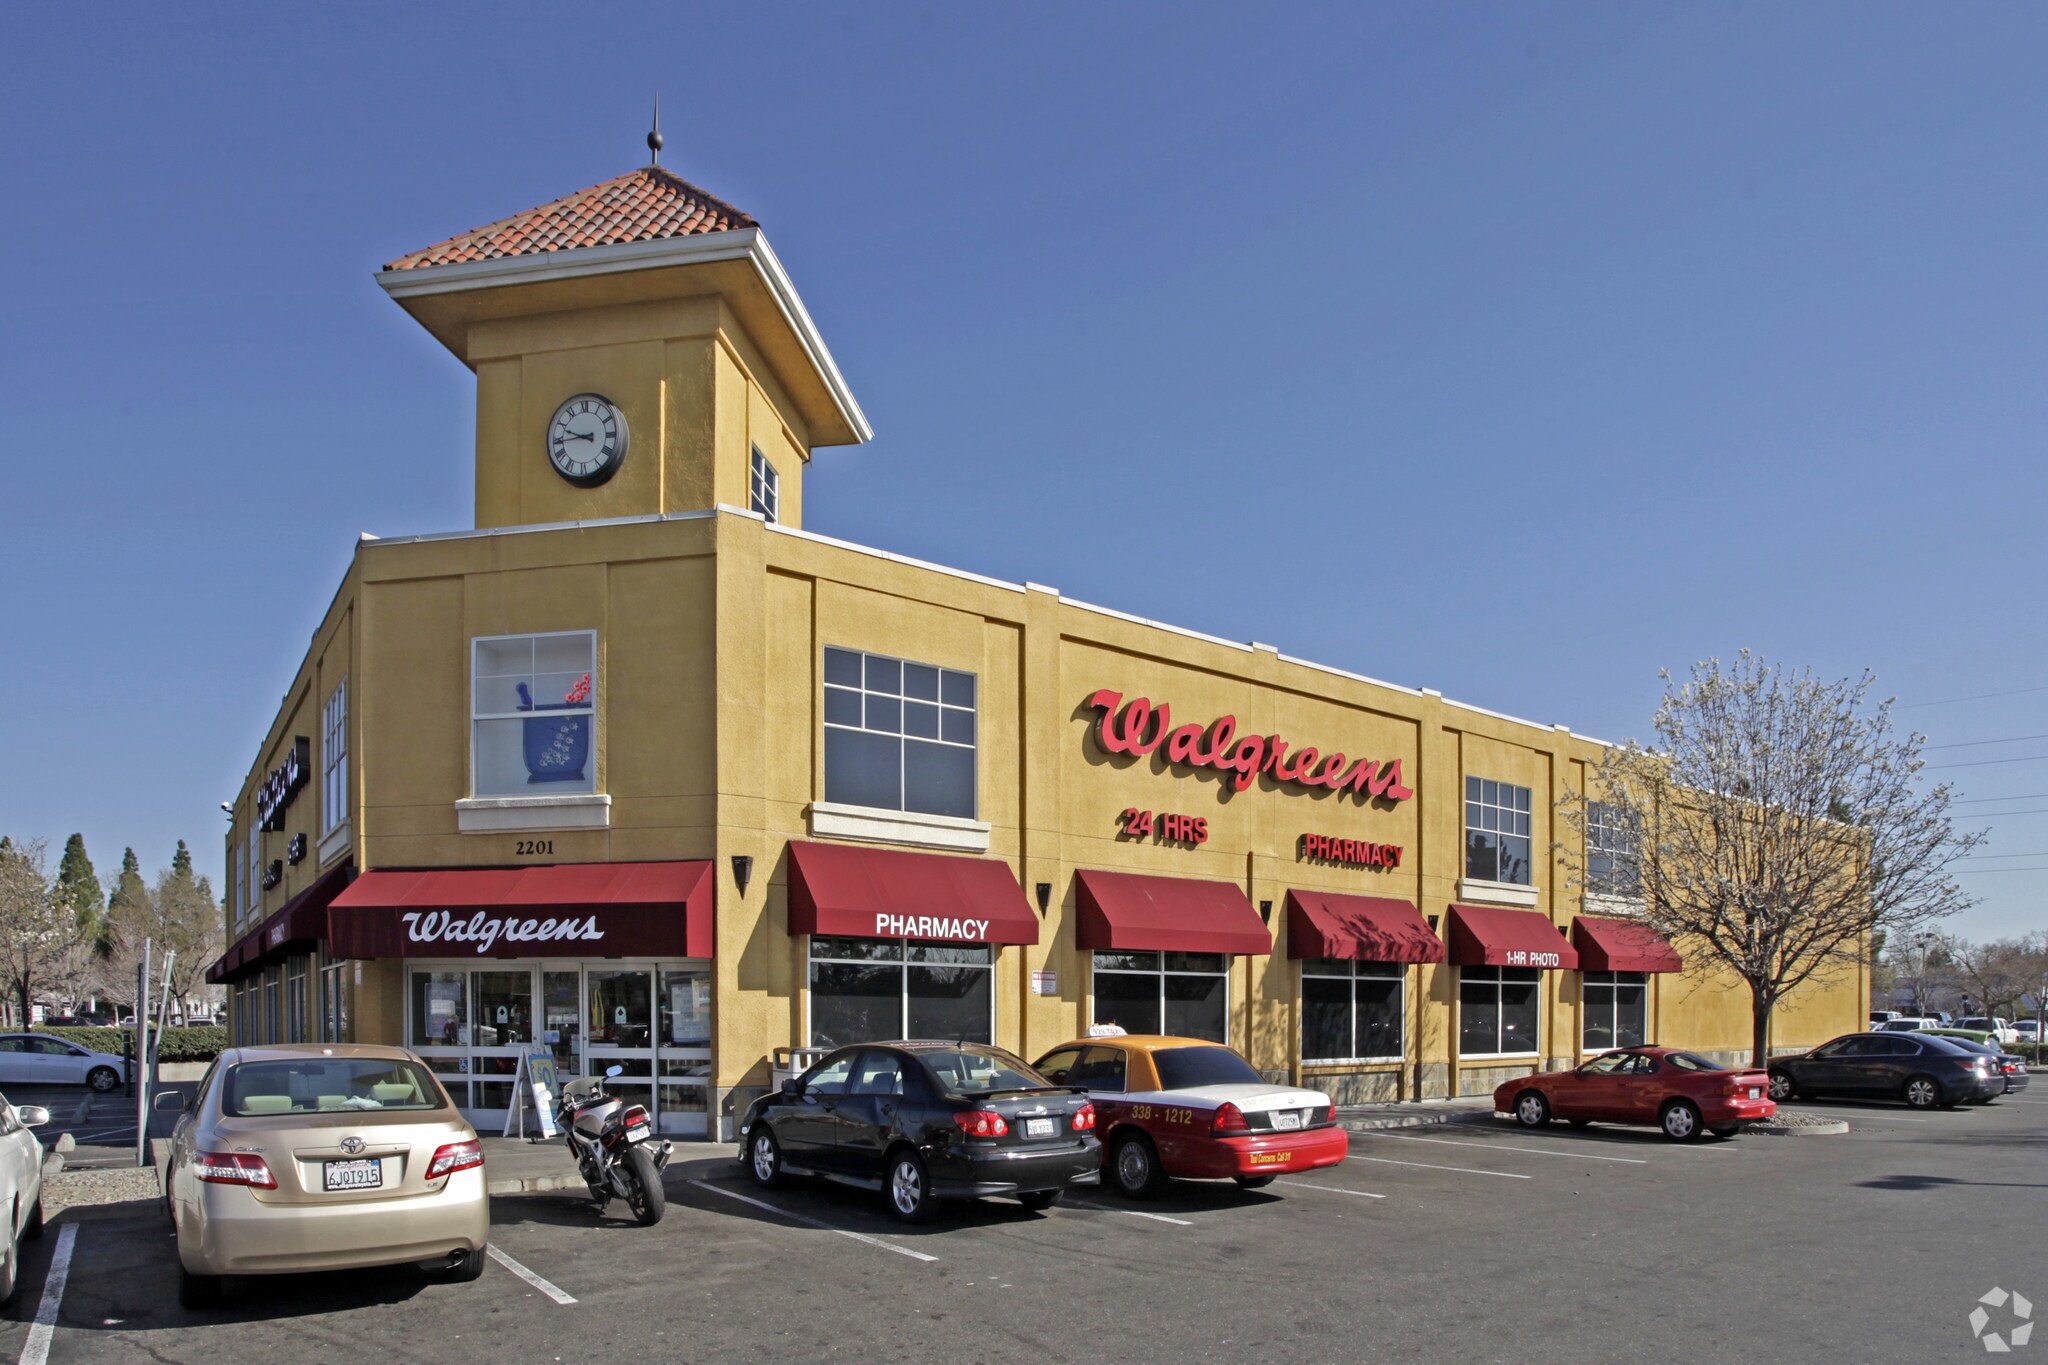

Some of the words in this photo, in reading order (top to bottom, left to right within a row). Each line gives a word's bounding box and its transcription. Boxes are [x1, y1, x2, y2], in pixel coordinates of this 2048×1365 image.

[1090, 688, 1413, 801] Walgreens
[1125, 807, 1154, 836] 24
[1164, 812, 1209, 844] HRS
[516, 840, 554, 855] 2201
[1305, 833, 1404, 868] PHARMACY
[402, 910, 605, 954] Walgreens
[875, 913, 989, 940] PHARMACY
[1506, 950, 1527, 965] 1-HR
[1530, 951, 1559, 967] PHOTO
[1131, 1105, 1152, 1120] 338
[1165, 1108, 1193, 1125] 1212
